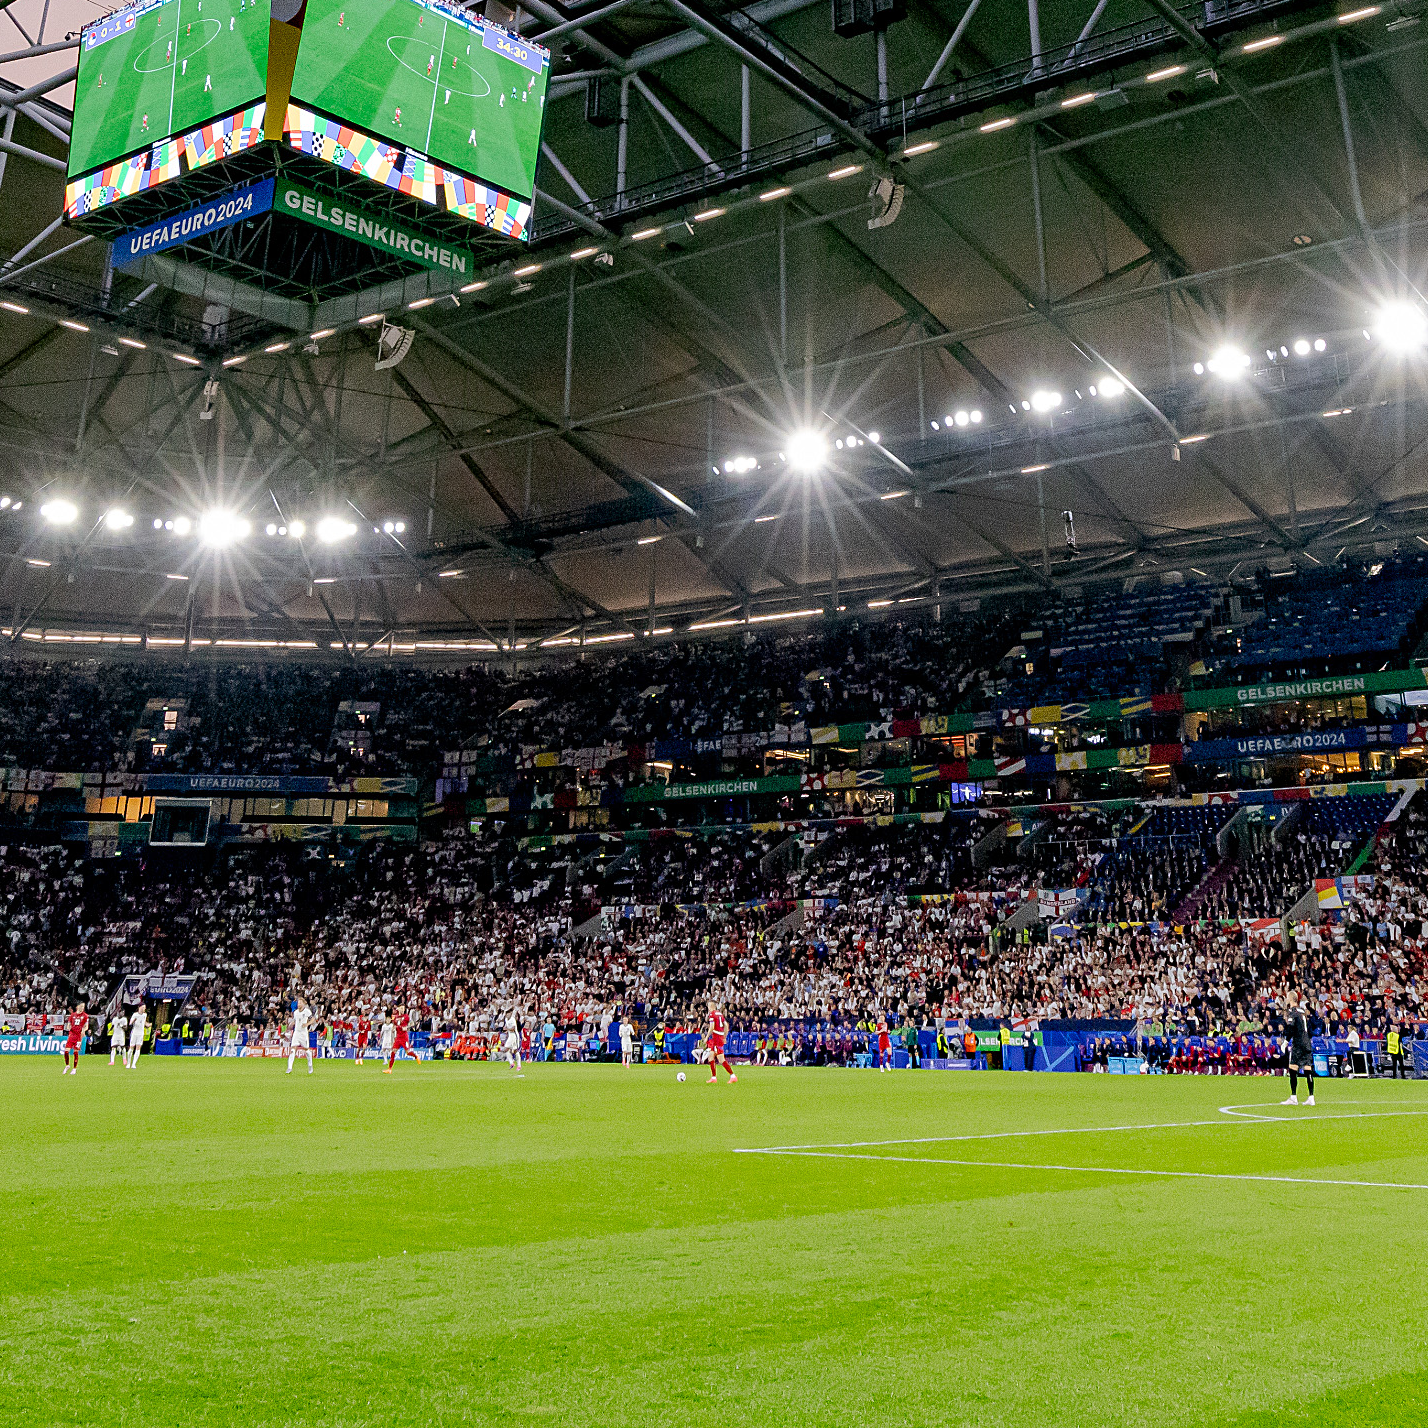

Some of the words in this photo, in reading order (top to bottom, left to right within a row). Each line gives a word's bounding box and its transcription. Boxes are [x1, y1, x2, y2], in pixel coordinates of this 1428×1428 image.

[496, 37, 528, 61] 34:30
[284, 189, 467, 273] GELSENKIRCHEN
[1237, 677, 1365, 700] GELSENKIRCHEN
[664, 781, 758, 798] GELSENKIRCHEN
